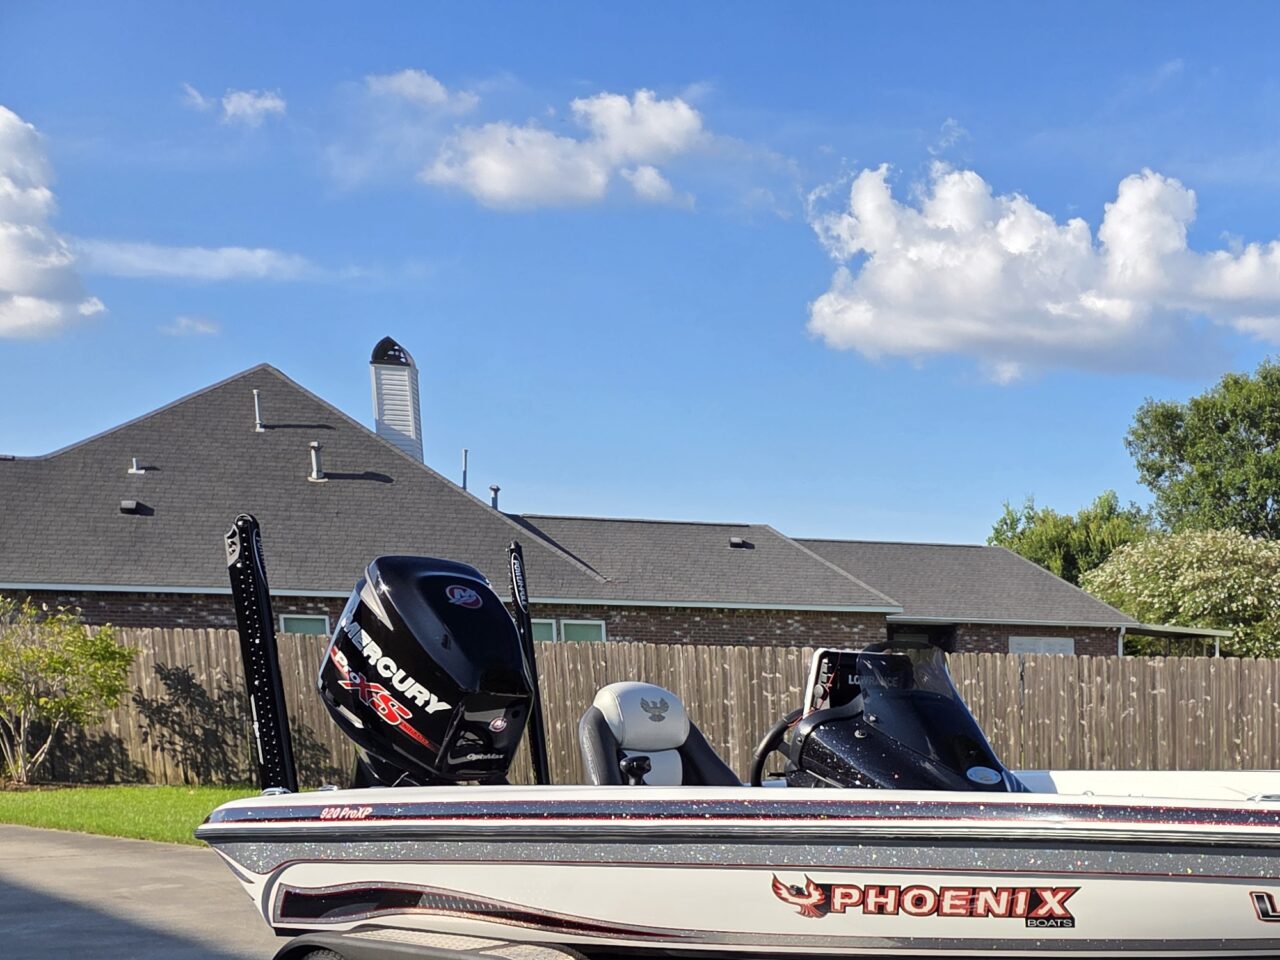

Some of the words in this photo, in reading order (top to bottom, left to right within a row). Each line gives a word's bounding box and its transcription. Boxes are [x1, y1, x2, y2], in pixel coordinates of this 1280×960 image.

[341, 617, 452, 714] MERCURY
[338, 672, 413, 725] XS
[829, 883, 1082, 918] PHOENIX
[1027, 918, 1073, 927] BOATS
